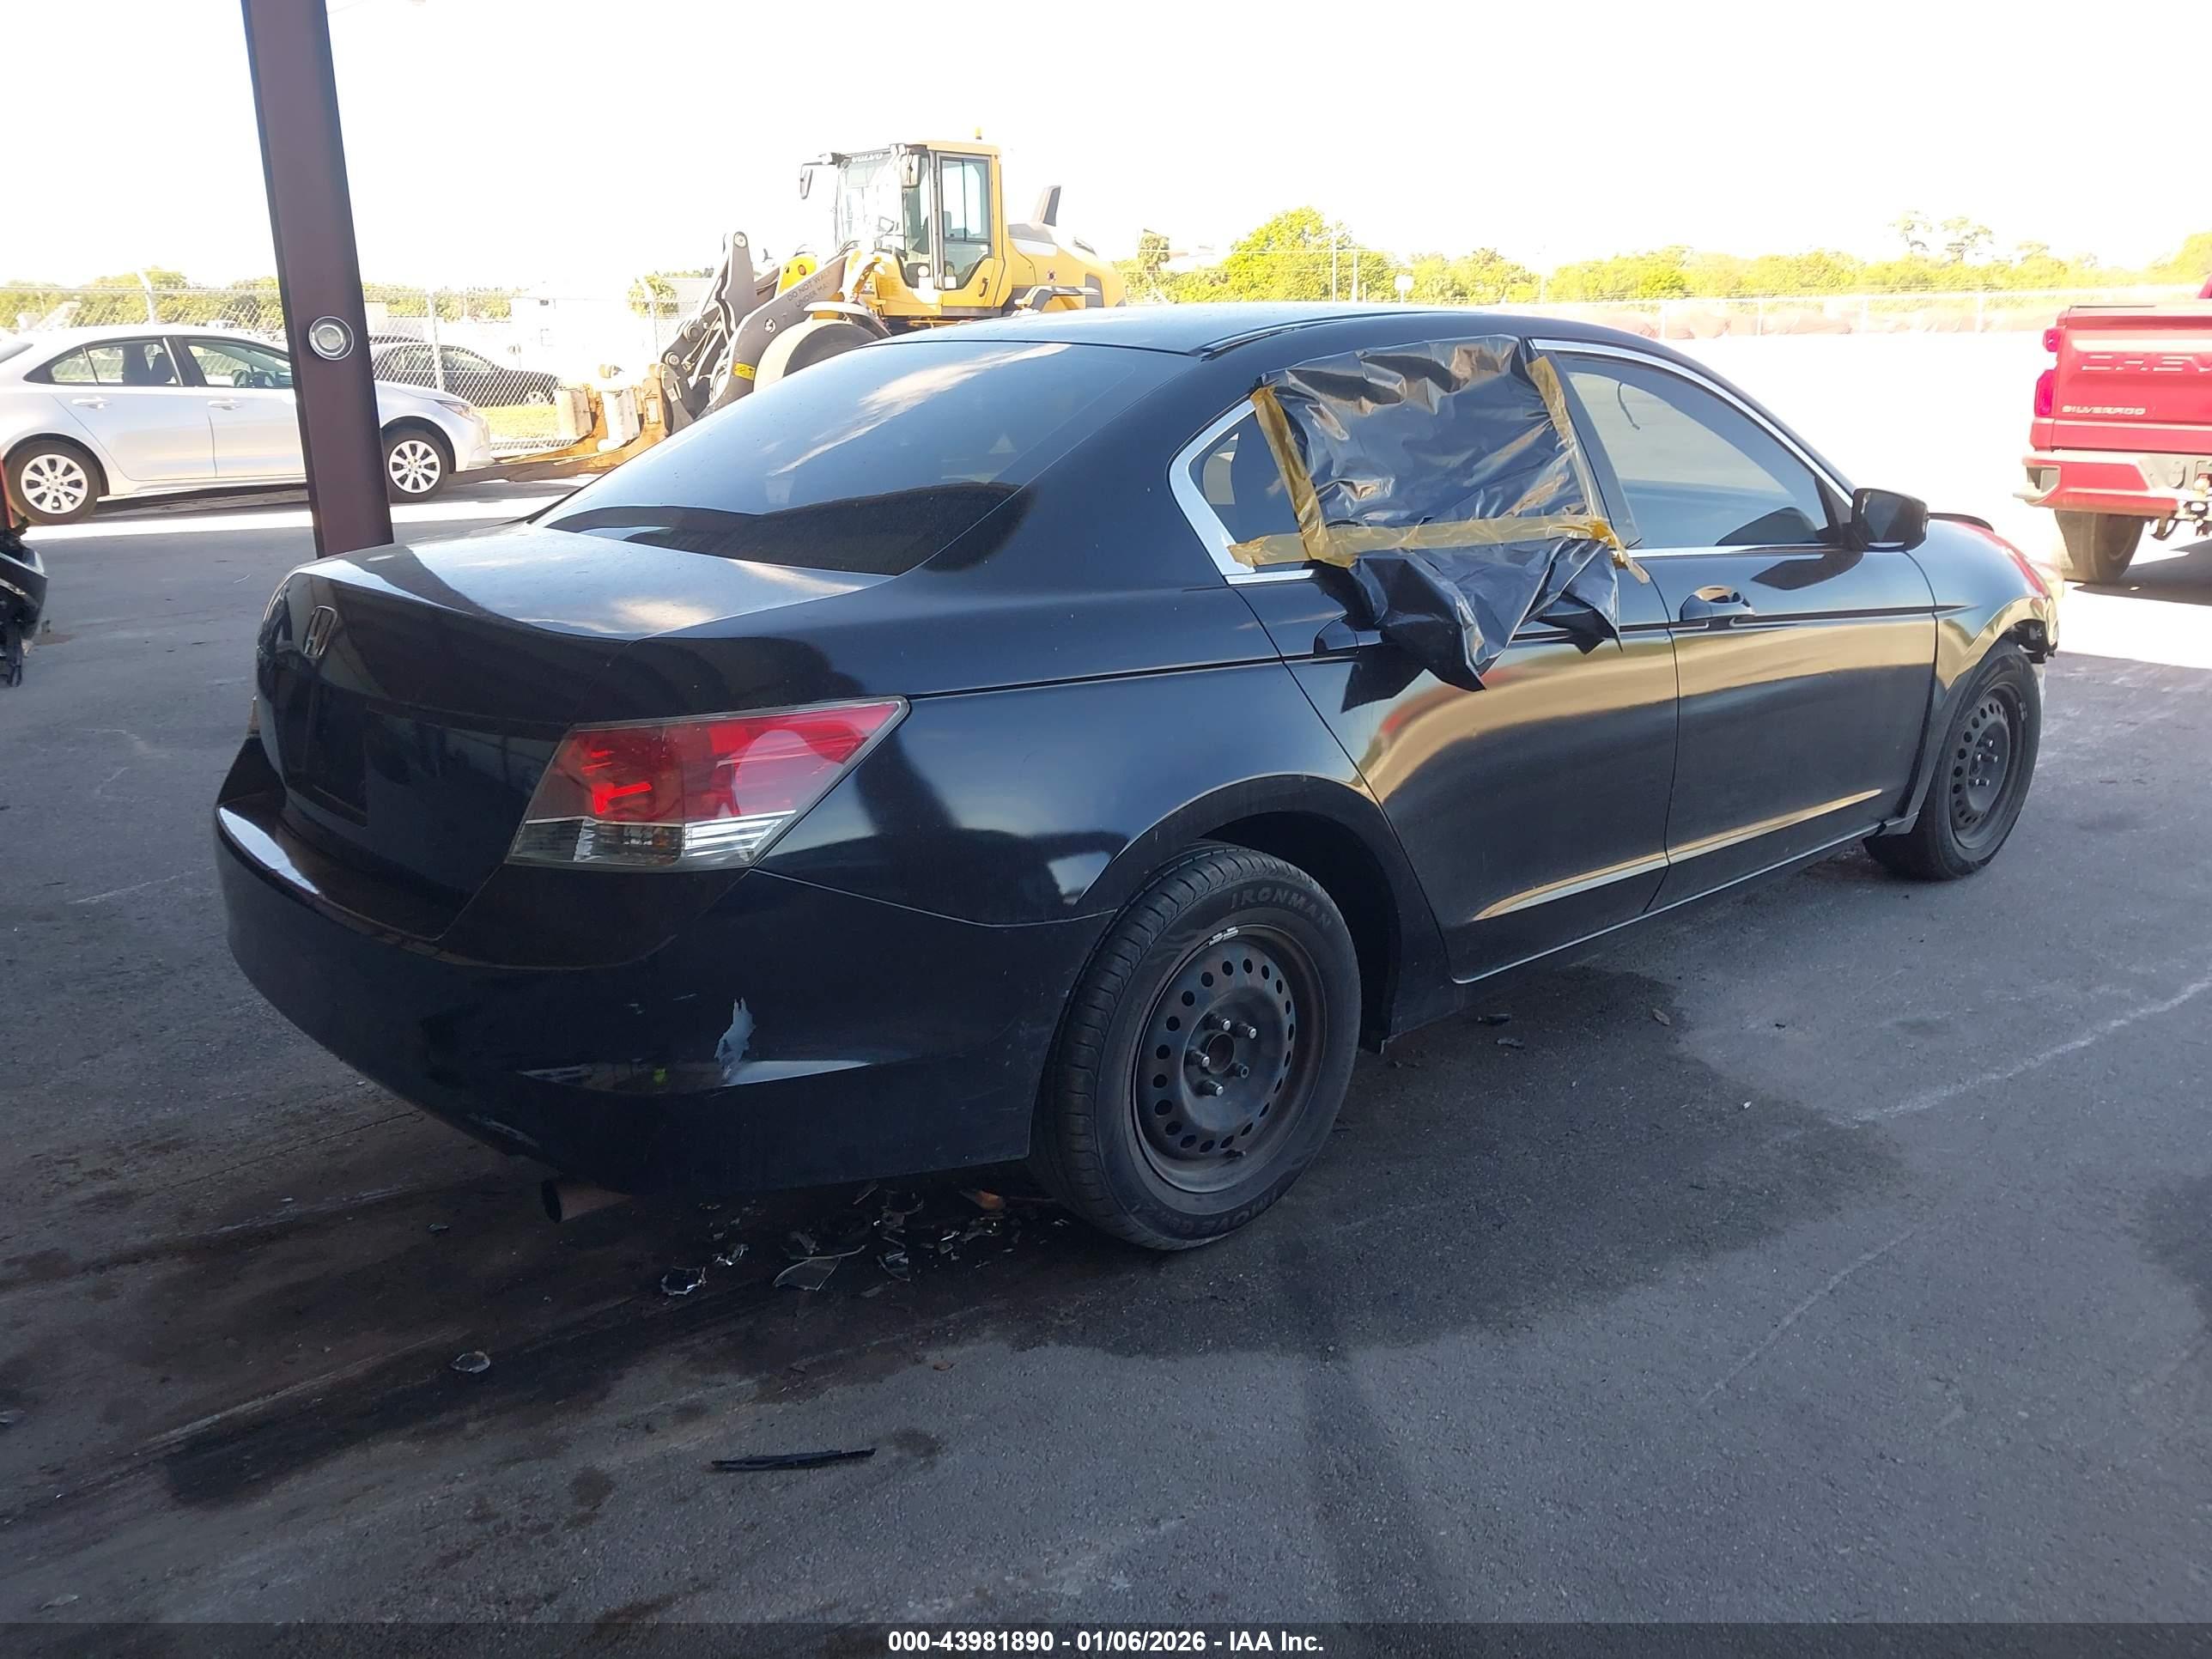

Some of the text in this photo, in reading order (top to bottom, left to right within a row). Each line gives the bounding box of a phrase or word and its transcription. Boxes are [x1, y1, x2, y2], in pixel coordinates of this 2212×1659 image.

[787, 291, 798, 301] DO
[798, 281, 812, 293] NOT
[2062, 404, 2146, 416] SILVERADO
[1230, 886, 1331, 929] IRONMAN
